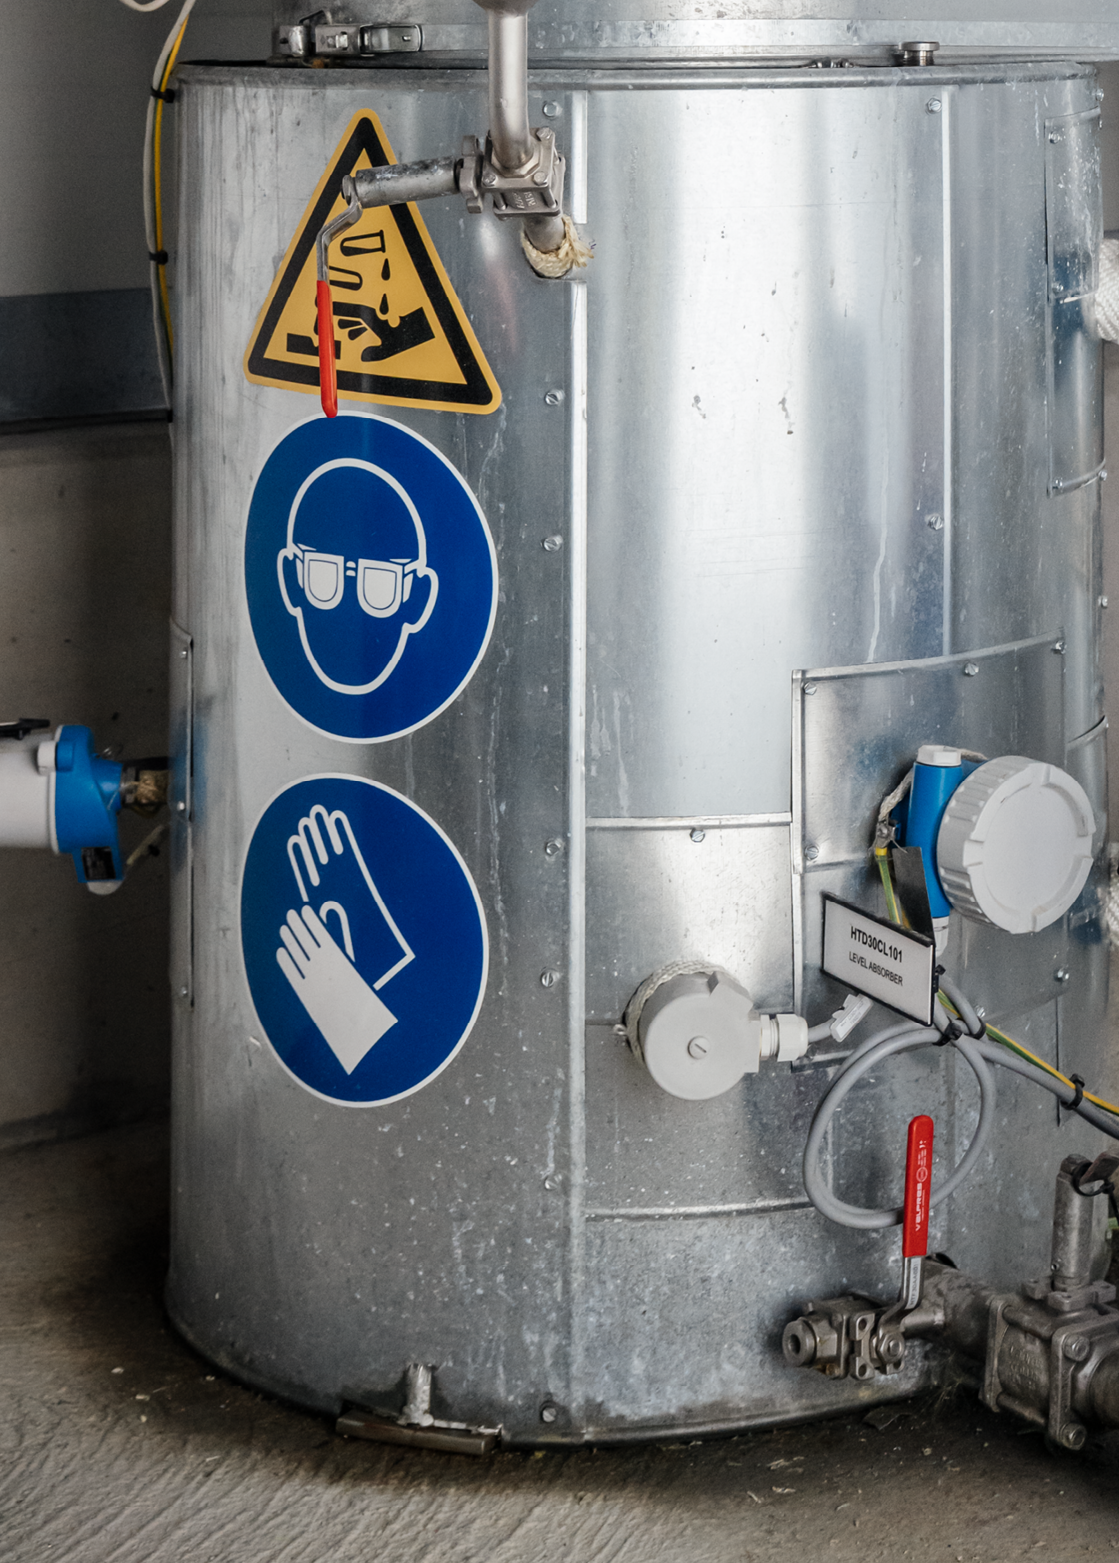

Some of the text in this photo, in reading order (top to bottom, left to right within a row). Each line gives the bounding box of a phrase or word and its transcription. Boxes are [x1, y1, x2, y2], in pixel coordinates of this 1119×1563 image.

[850, 925, 902, 963] HTD30CL101
[849, 951, 903, 986] LEVEL ABSORBER
